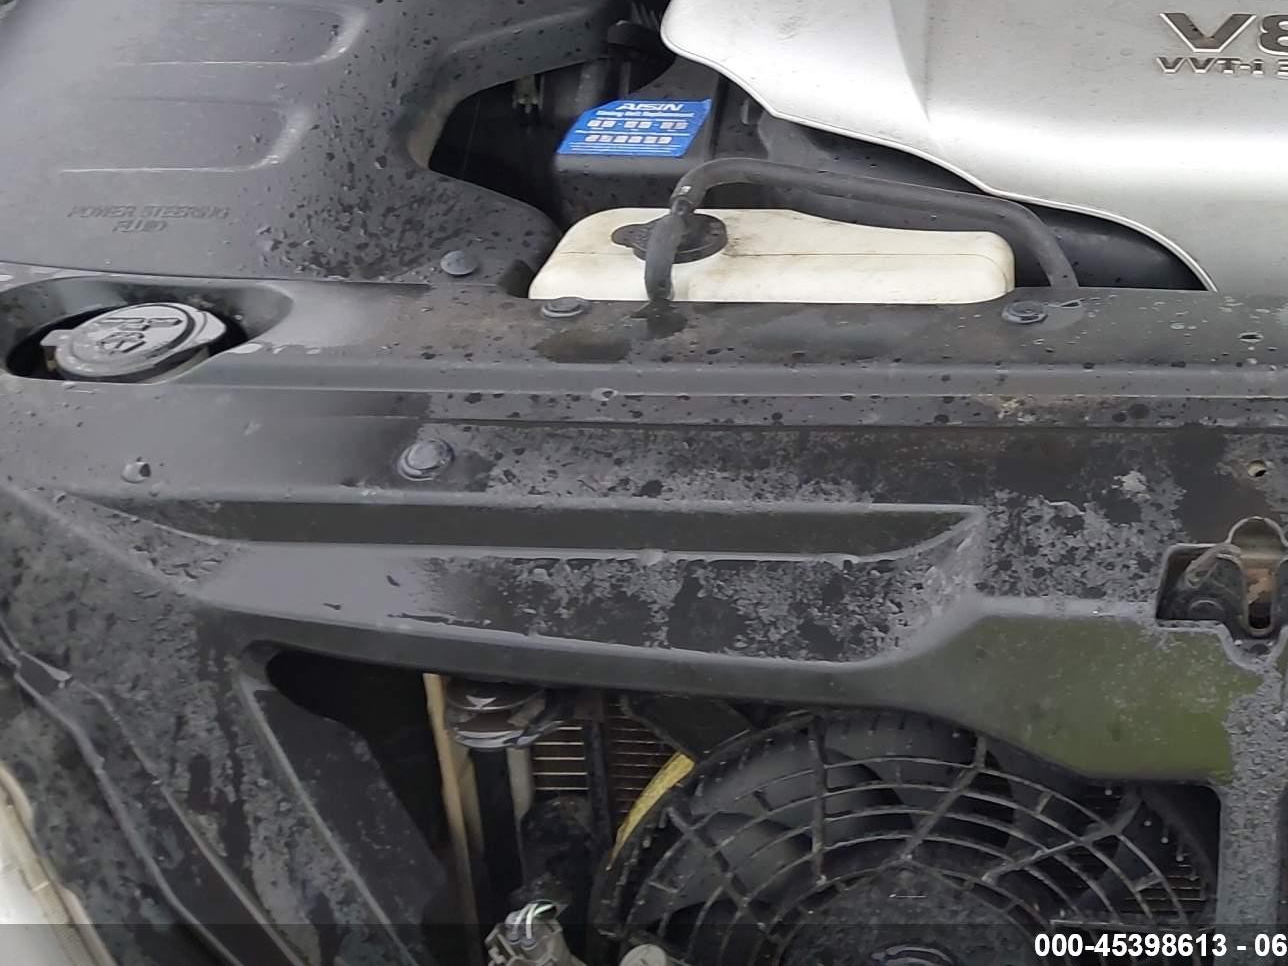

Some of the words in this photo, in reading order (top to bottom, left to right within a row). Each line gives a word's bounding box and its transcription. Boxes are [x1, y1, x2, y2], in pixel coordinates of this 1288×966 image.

[1155, 56, 1265, 75] VVT-i
[616, 103, 685, 111] AISIN
[66, 204, 137, 219] POWER
[140, 204, 232, 220] STEERING
